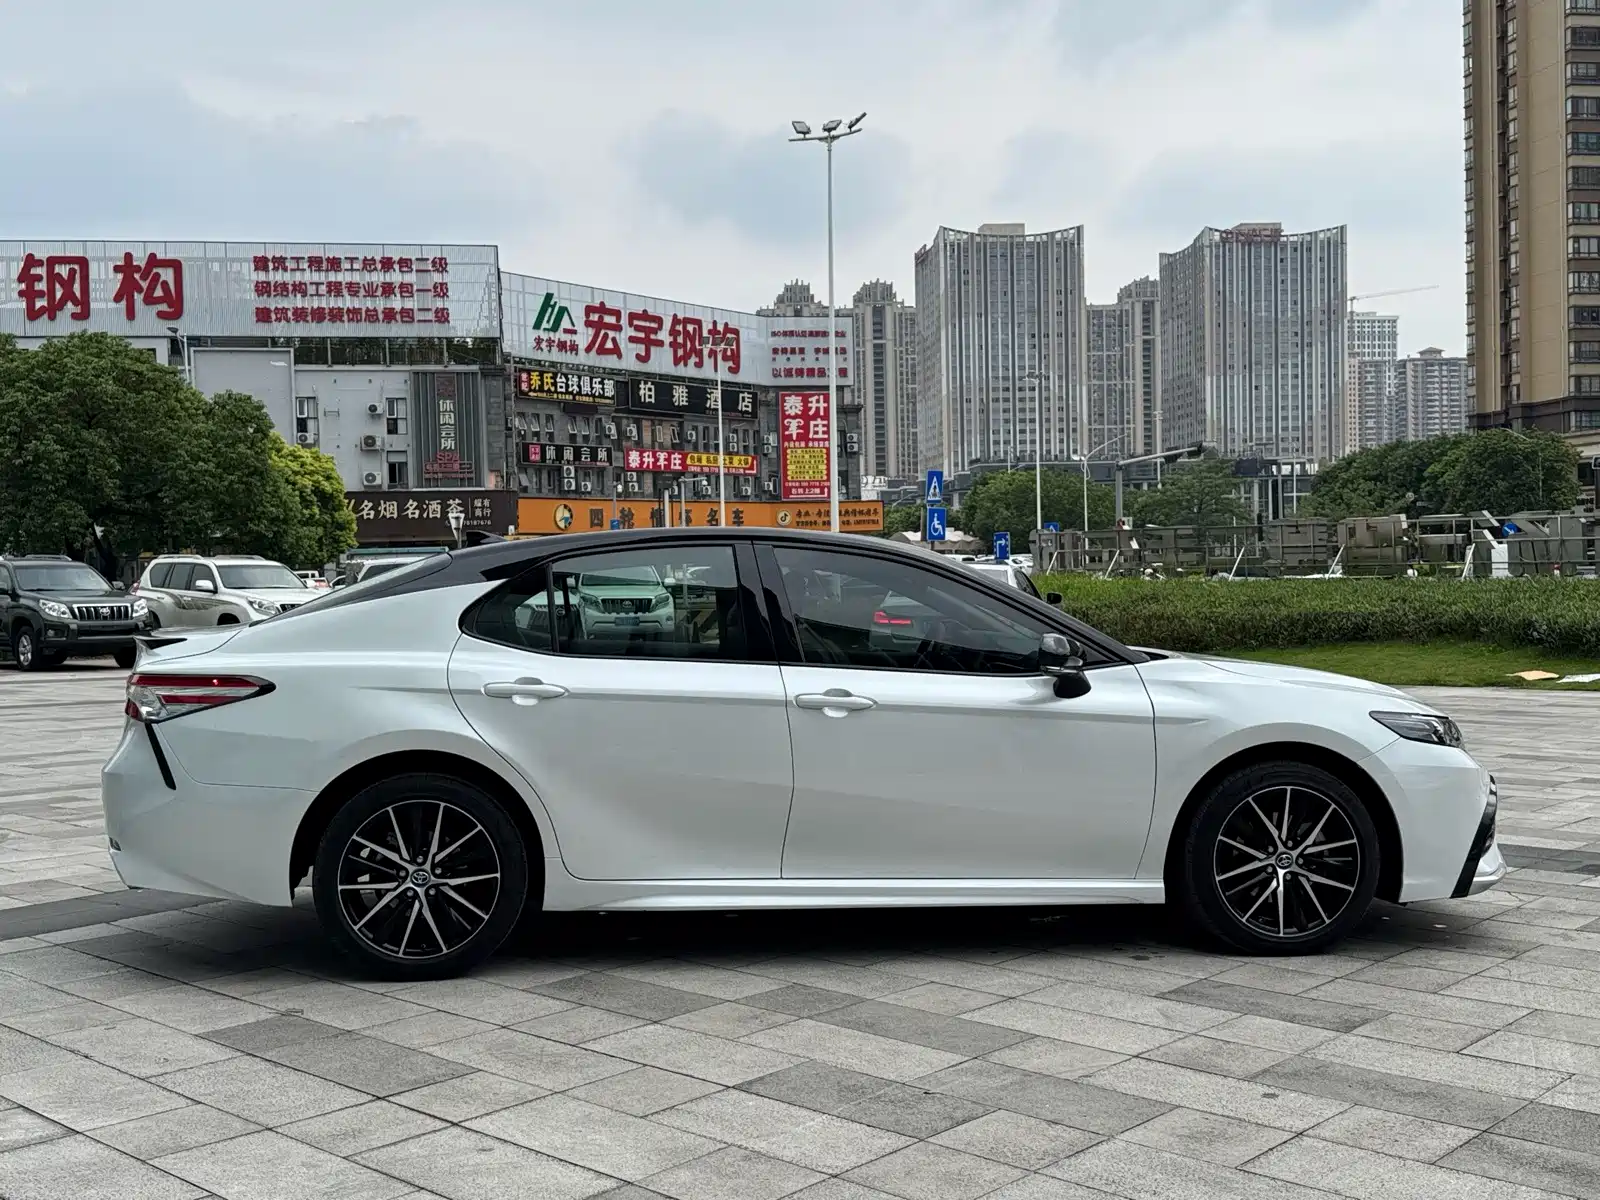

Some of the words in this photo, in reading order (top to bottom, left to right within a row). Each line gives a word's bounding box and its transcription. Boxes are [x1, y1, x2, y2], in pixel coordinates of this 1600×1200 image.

[253, 256, 449, 273] 建筑工程施工总承包二级
[17, 251, 184, 321] 钢构
[254, 281, 450, 298] 钢结构工程专业承包一级
[255, 306, 451, 324] 建筑装修装饰总承包二级
[532, 335, 580, 357] 宏宇钢构
[584, 301, 741, 374] 宏宇钢构
[530, 372, 615, 397] 乔氏台球俱乐部
[639, 380, 752, 412] 柏雅酒店
[784, 395, 828, 416] 泰升
[439, 400, 456, 450] 休闲会所
[784, 418, 828, 441] 羊庄
[546, 445, 608, 462] 休闲会所
[628, 450, 682, 470] 泰升羊庄
[358, 499, 465, 519] 名烟名酒茶
